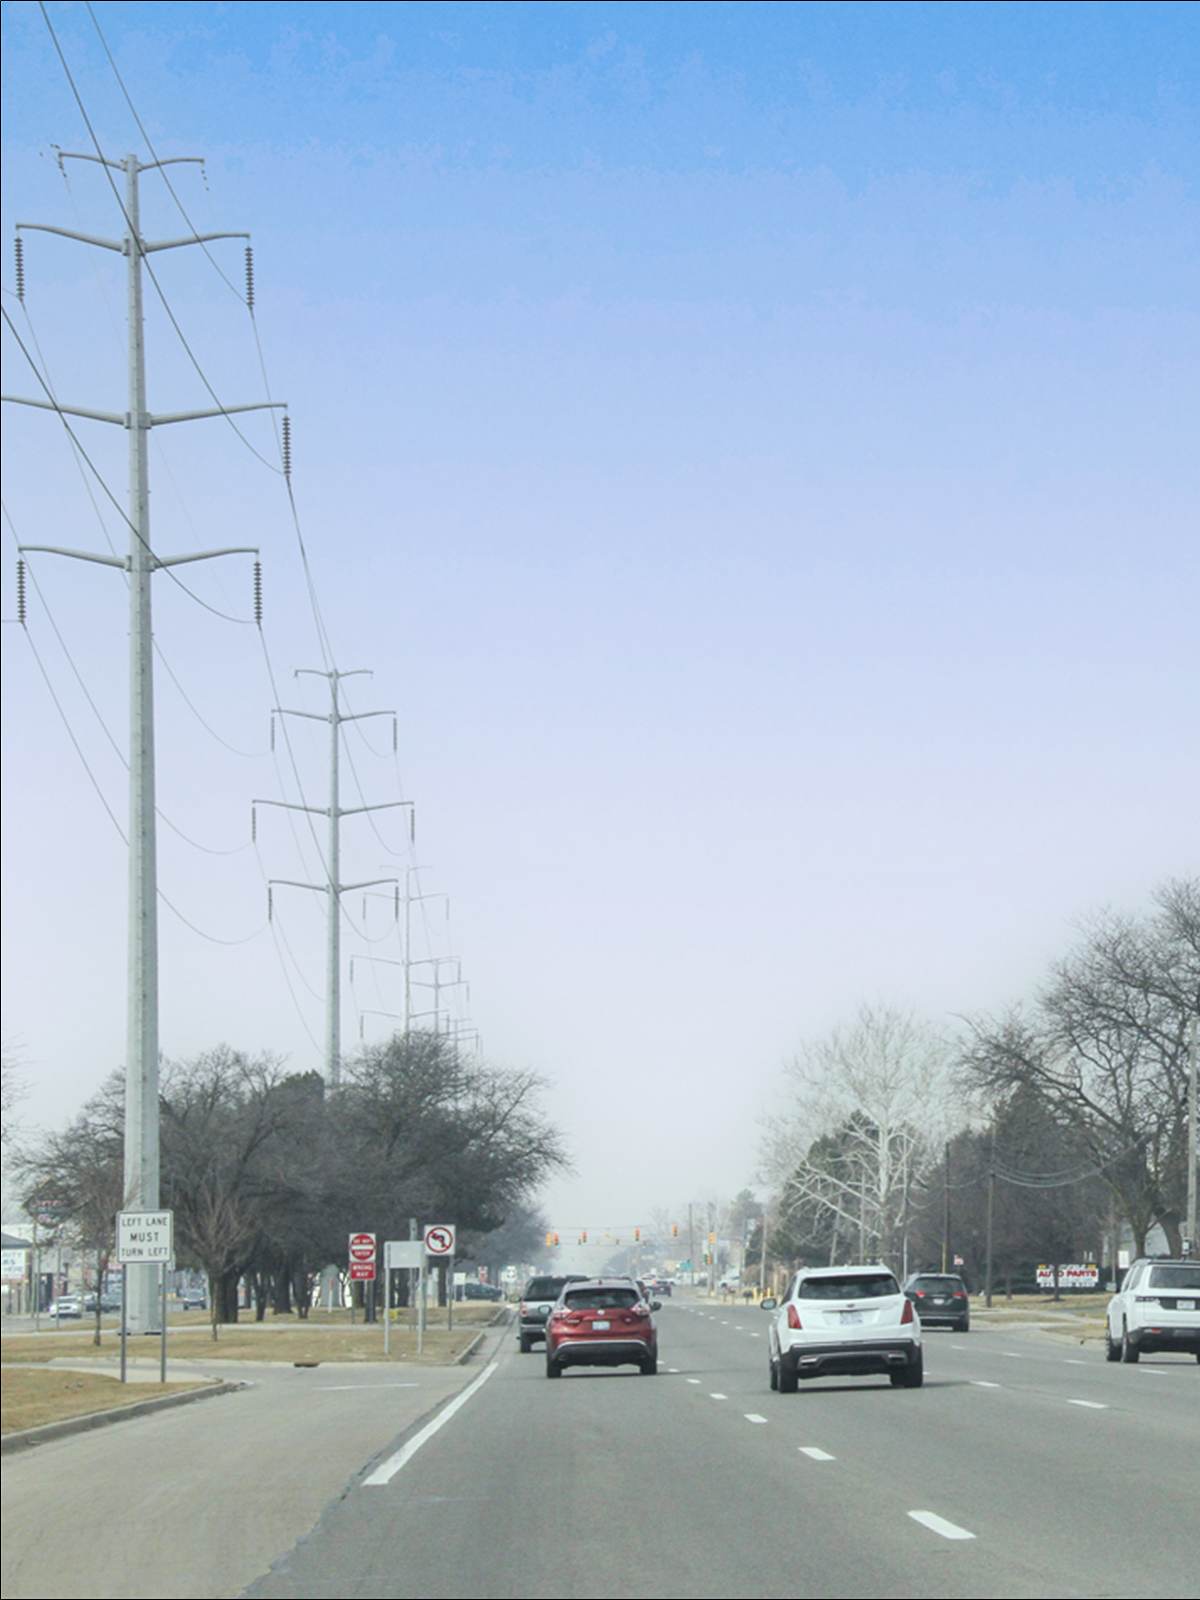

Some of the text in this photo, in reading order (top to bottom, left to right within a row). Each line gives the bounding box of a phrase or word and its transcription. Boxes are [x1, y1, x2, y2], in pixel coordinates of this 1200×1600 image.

[121, 1216, 168, 1227] LEFT LANE
[130, 1231, 159, 1242] MUST
[121, 1246, 168, 1256] TURN LEFT
[1038, 1270, 1097, 1278] AUTO PARTS
